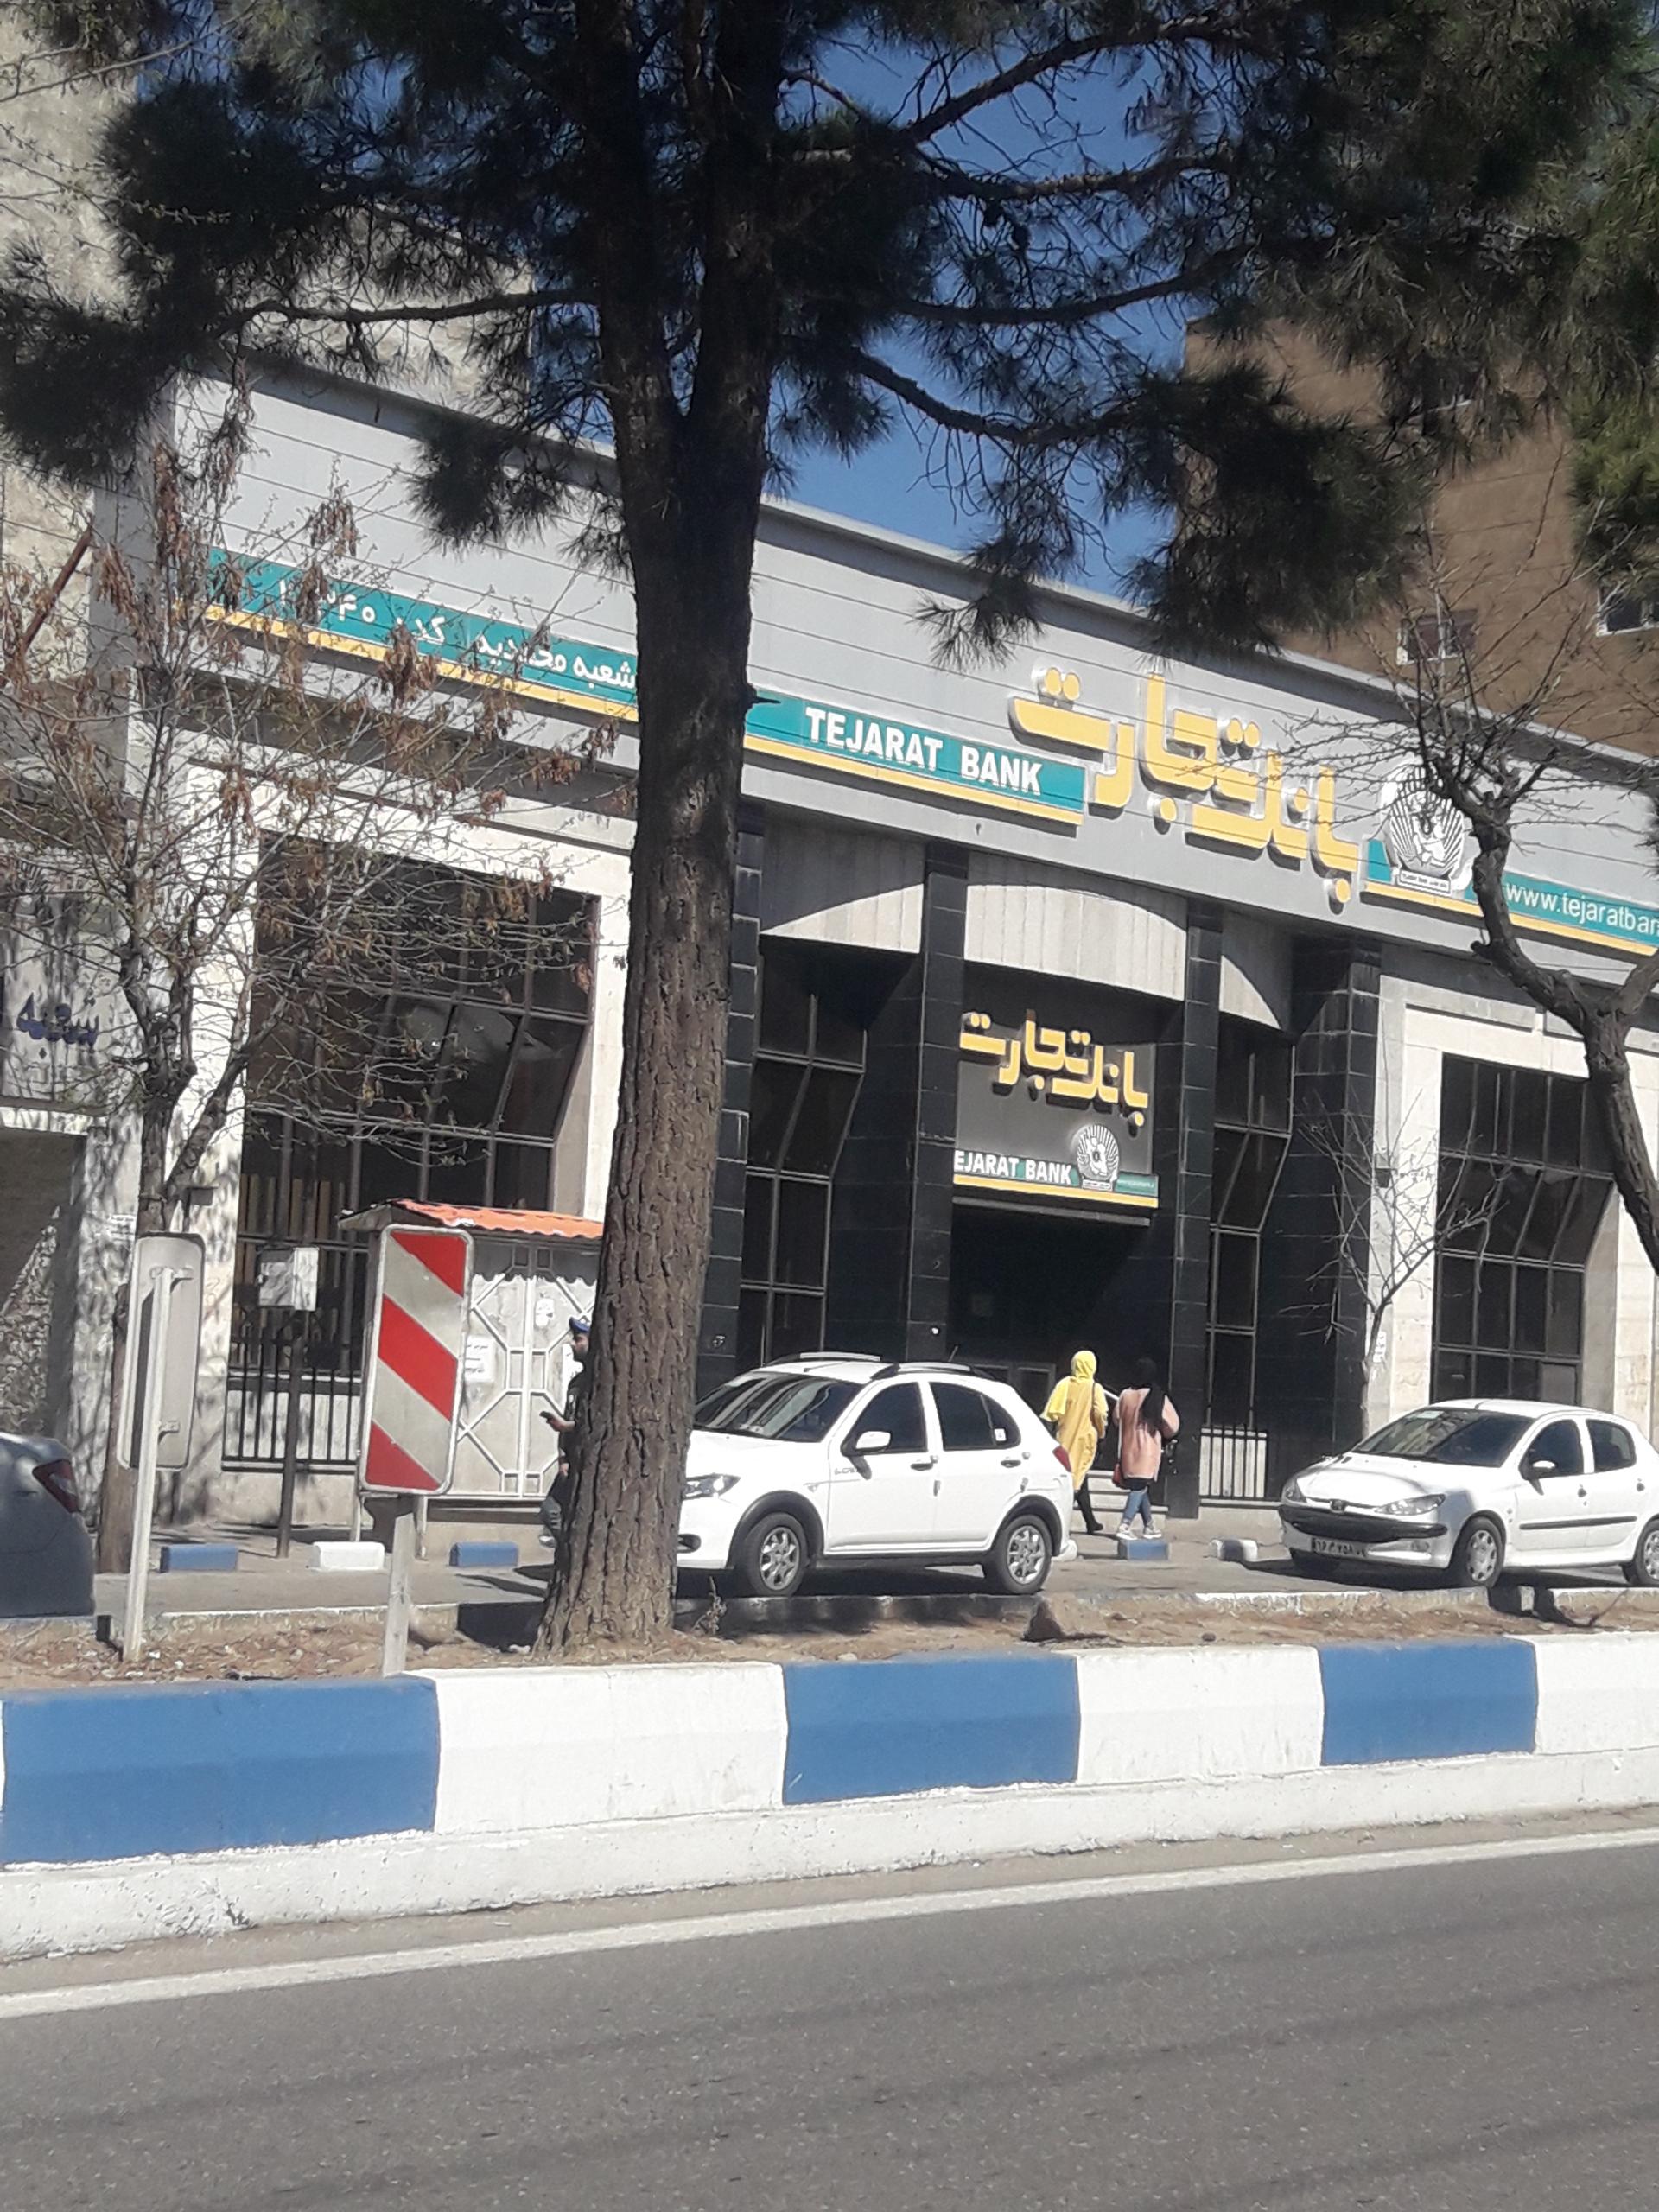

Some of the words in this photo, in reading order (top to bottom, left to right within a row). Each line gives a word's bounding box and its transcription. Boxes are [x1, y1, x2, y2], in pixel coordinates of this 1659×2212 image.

[573, 656, 636, 688] شعبه
[805, 705, 943, 771] TEJARAT
[961, 745, 1043, 795] BANK
[1013, 667, 1262, 823] تجارت
[1192, 749, 1360, 905] بانک
[959, 1008, 1091, 1090] تجارت
[1051, 1044, 1148, 1127] بانک
[1025, 1159, 1072, 1185] BANK
